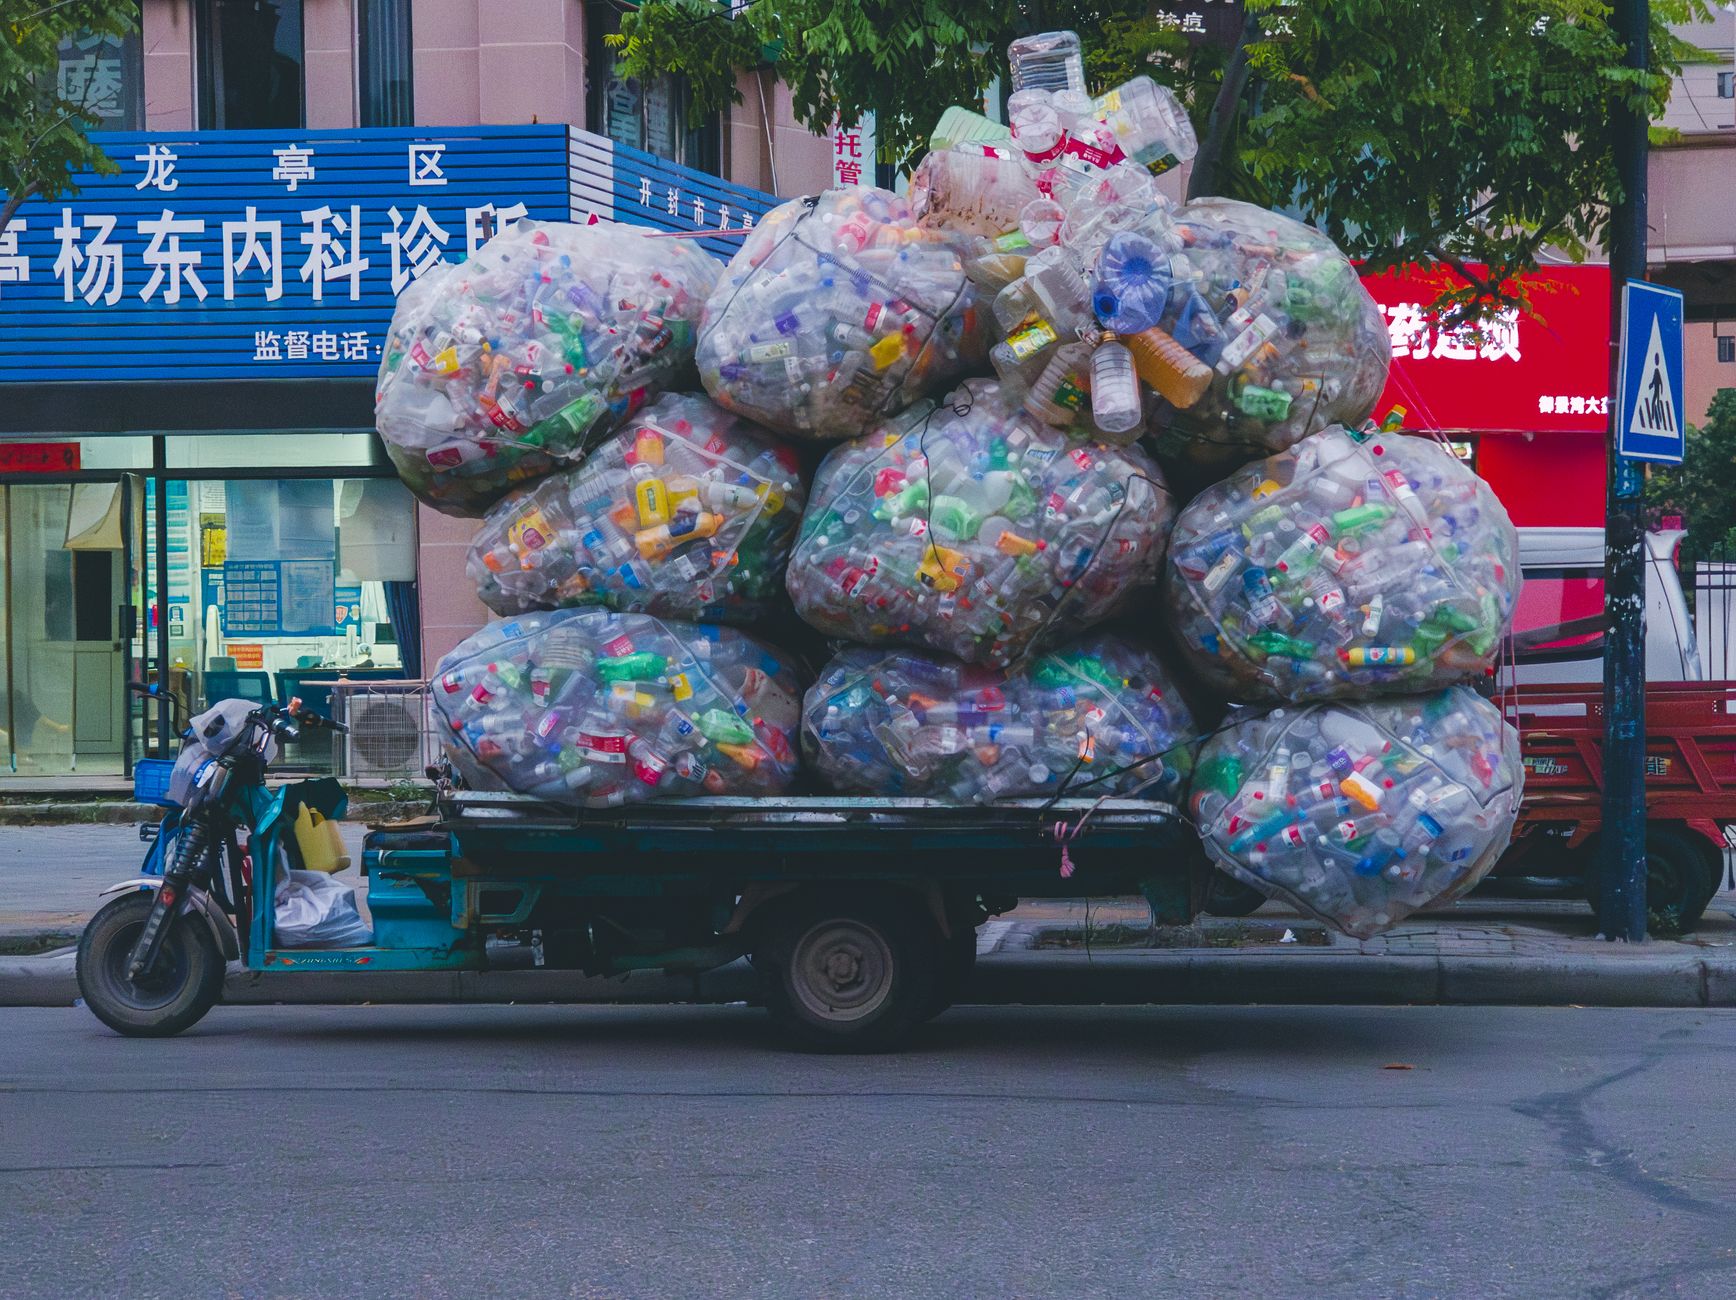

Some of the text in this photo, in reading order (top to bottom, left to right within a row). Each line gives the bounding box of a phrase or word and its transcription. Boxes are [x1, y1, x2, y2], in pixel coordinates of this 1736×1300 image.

[135, 143, 447, 192] 龙亭区
[834, 113, 862, 185] 托管
[1378, 302, 1521, 362] 药连锁
